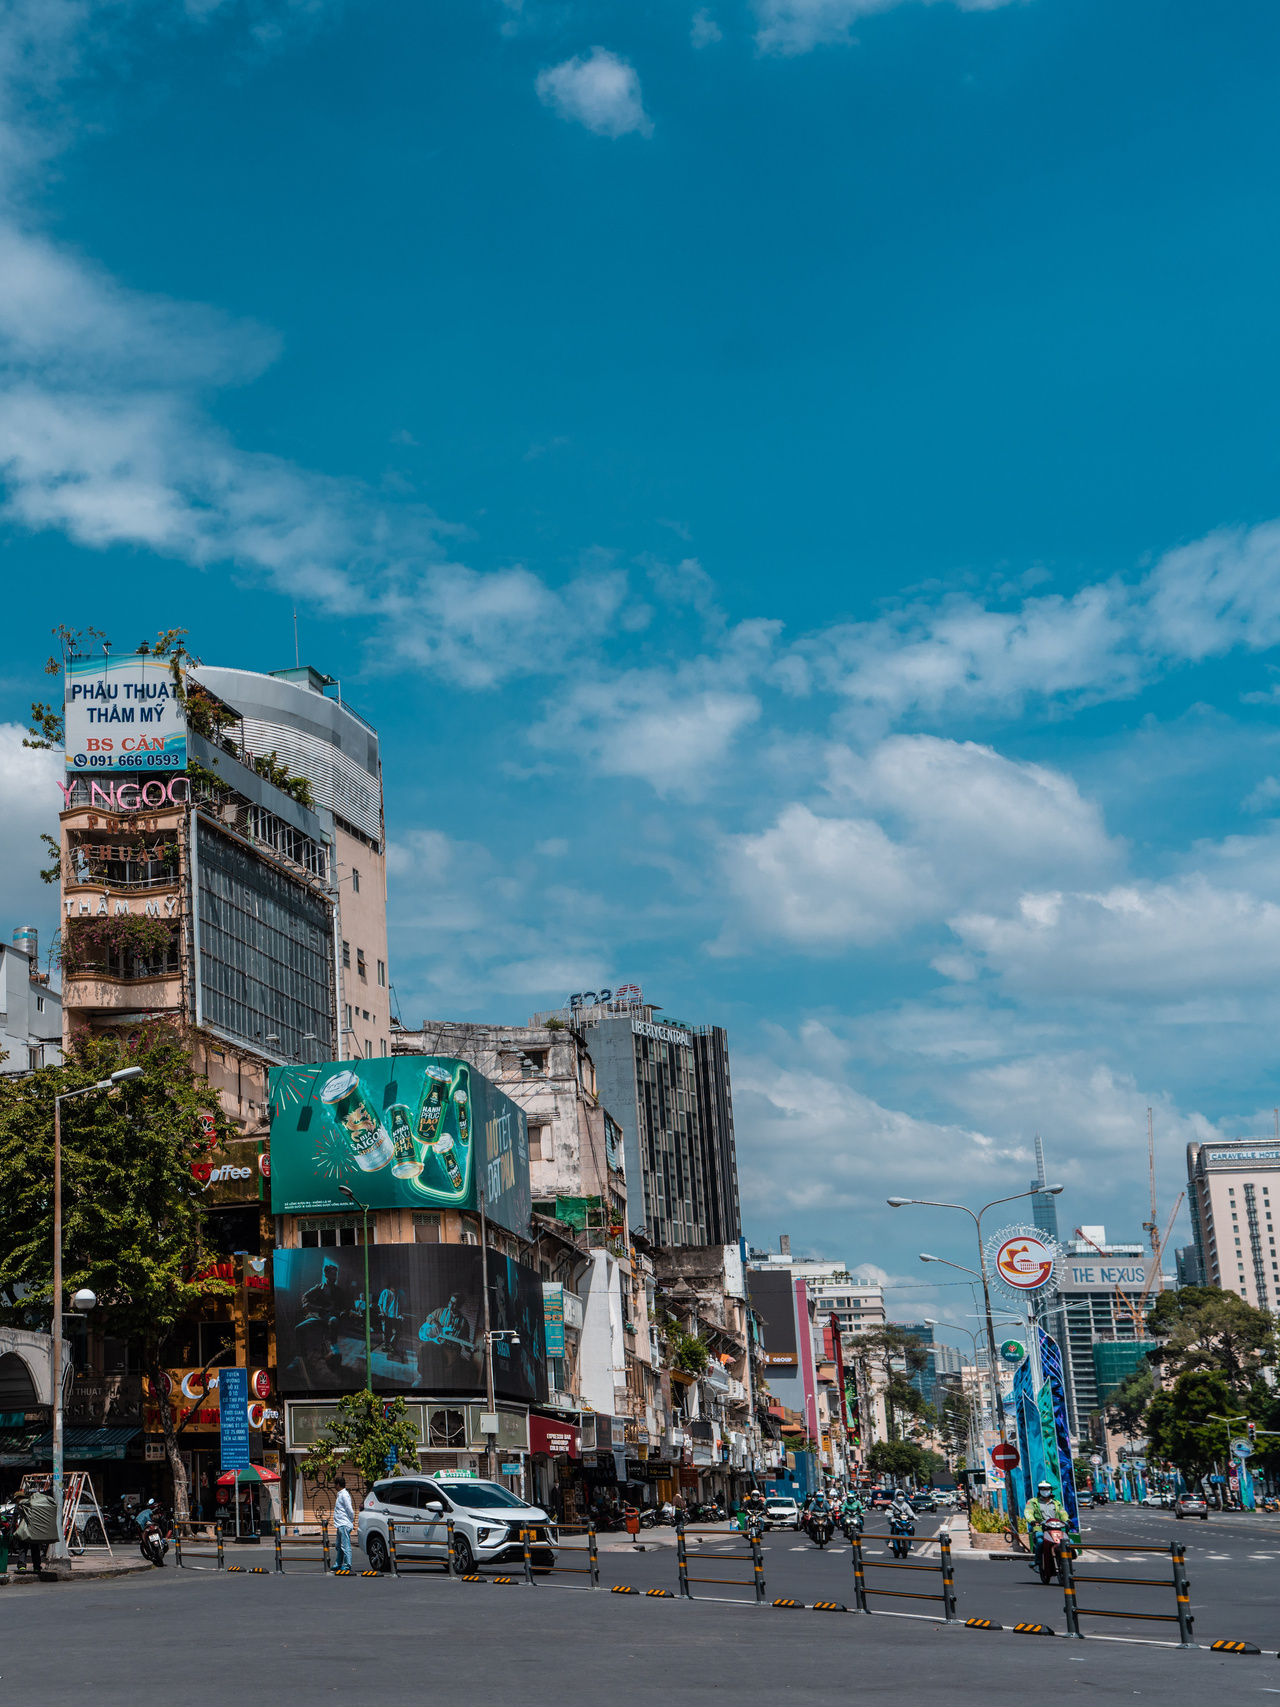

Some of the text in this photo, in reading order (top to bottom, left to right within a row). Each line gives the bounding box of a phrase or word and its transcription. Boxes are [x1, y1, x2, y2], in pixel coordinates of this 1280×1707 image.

[72, 681, 178, 702] PHẪU THUẬT
[87, 704, 165, 723] THẨM MỸ
[86, 734, 166, 752] BS CĂN
[89, 754, 179, 766] 091 666 0593
[1211, 1151, 1280, 1160] CARAVELLE HOTE
[210, 1165, 252, 1181] offee
[1072, 1268, 1145, 1282] THE NEXUS
